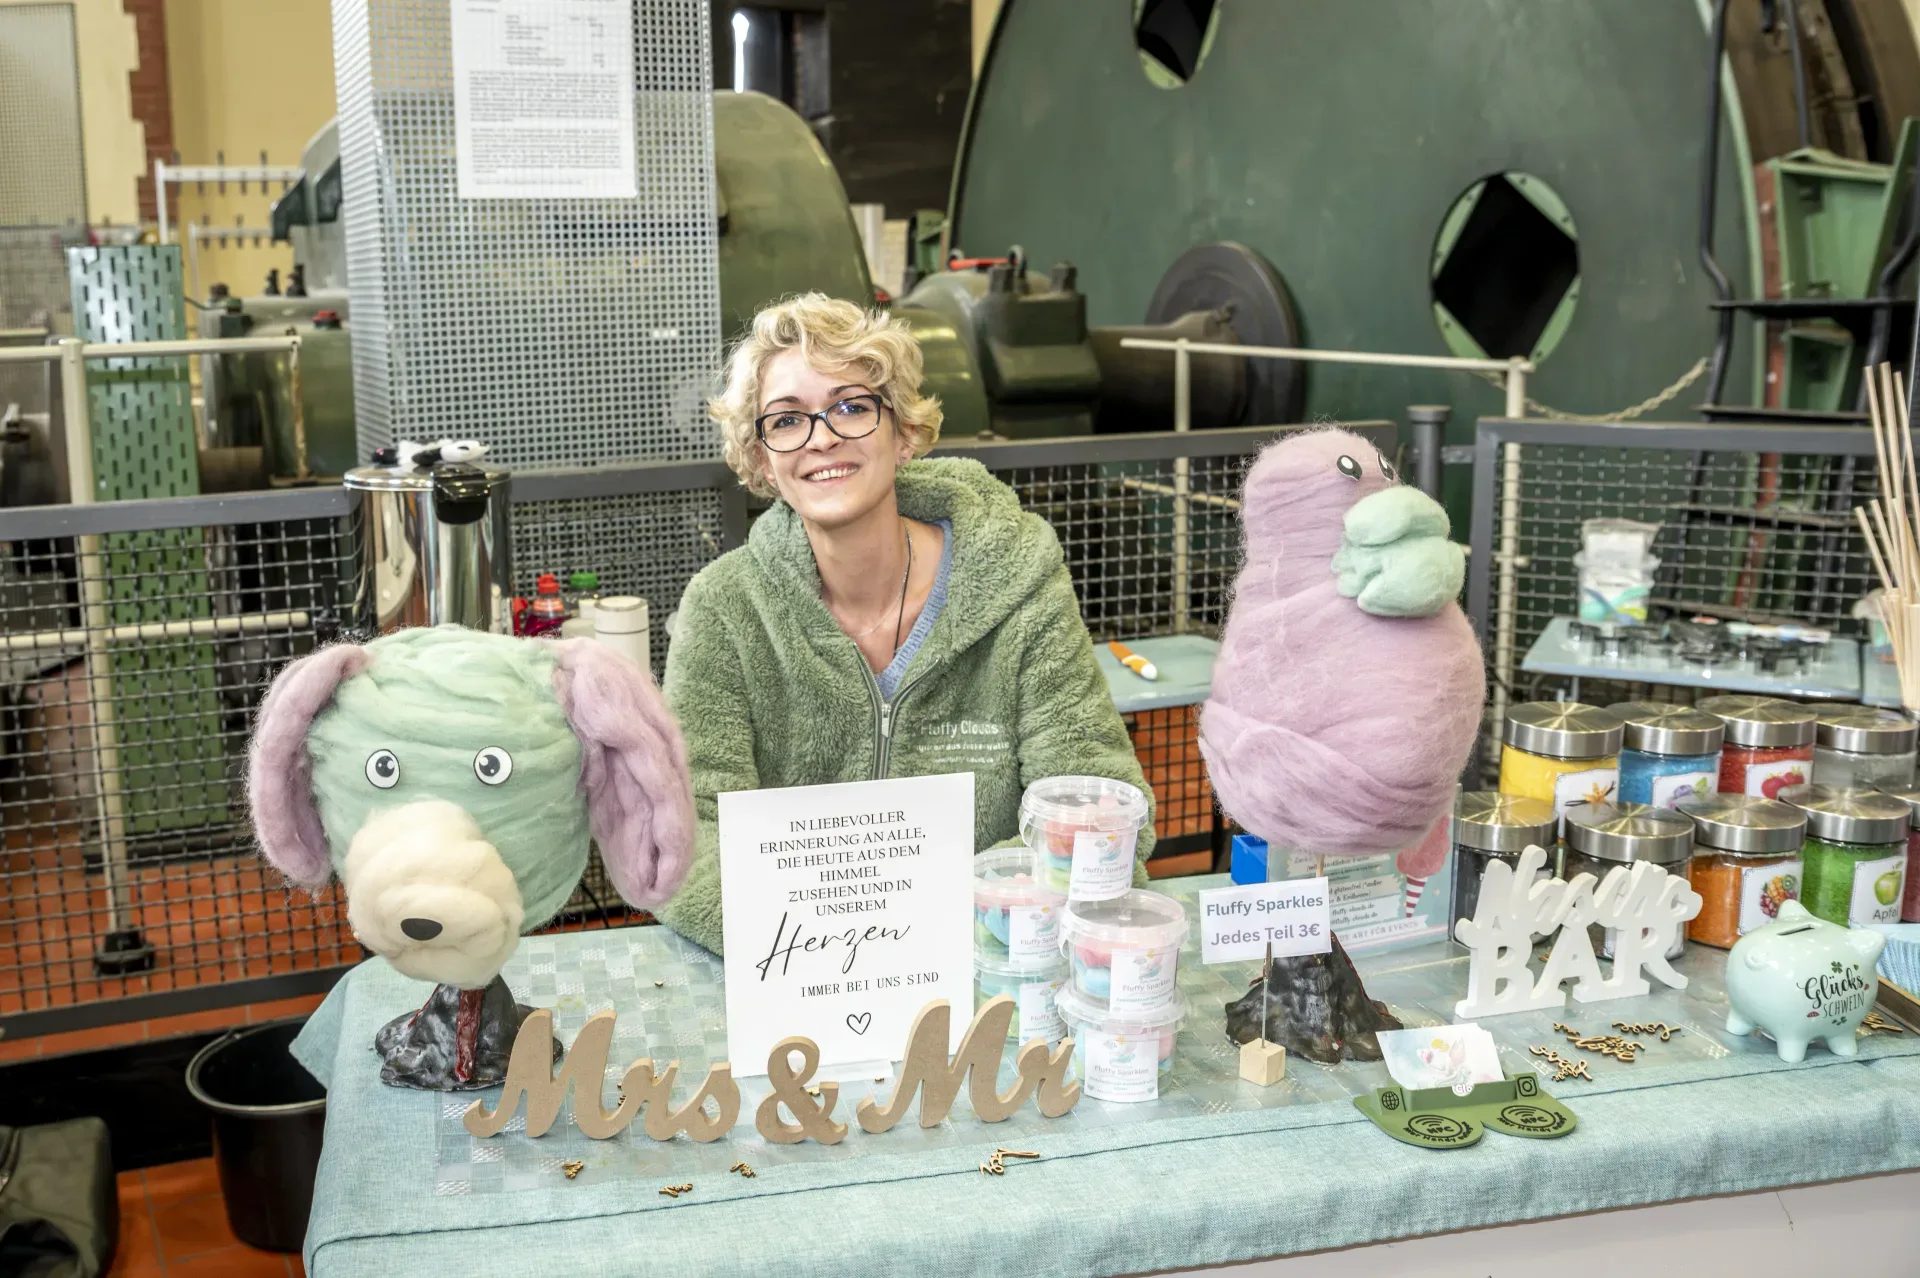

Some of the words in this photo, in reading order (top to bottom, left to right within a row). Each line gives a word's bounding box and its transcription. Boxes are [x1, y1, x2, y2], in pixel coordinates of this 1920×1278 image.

[790, 820, 806, 832] IN
[810, 811, 906, 831] LIEBEVOLLER
[760, 834, 860, 854] ERINNERUNG
[863, 831, 885, 844] AN
[887, 827, 927, 842] ALLE,
[777, 857, 801, 869] DIE
[804, 851, 854, 867] HEUTE
[857, 848, 886, 862] AUS
[889, 844, 921, 858] DEM
[819, 866, 881, 882] HIMMEL
[788, 885, 858, 902] ZUSEHEN
[861, 881, 894, 895] UND
[896, 879, 912, 891] IN
[816, 899, 887, 916] UNSEREM
[1206, 900, 1252, 917] Fluffy
[1256, 895, 1324, 914] Sparkles
[1872, 905, 1900, 923] Apfel
[756, 911, 911, 981] Herzen
[1211, 929, 1261, 946] Jedes
[1264, 924, 1294, 941] Teil
[1298, 923, 1321, 938] 3€
[1455, 905, 1689, 1019] BAR
[800, 983, 840, 998] IMMER
[846, 980, 870, 993] BEI
[877, 976, 901, 989] UNS
[907, 971, 939, 986] SIND
[1796, 967, 1864, 1009] Glücks
[1822, 991, 1865, 1018] SCHWEIN
[462, 1008, 741, 1143] Mrs
[755, 1035, 849, 1146] &
[856, 993, 1080, 1134] Mr
